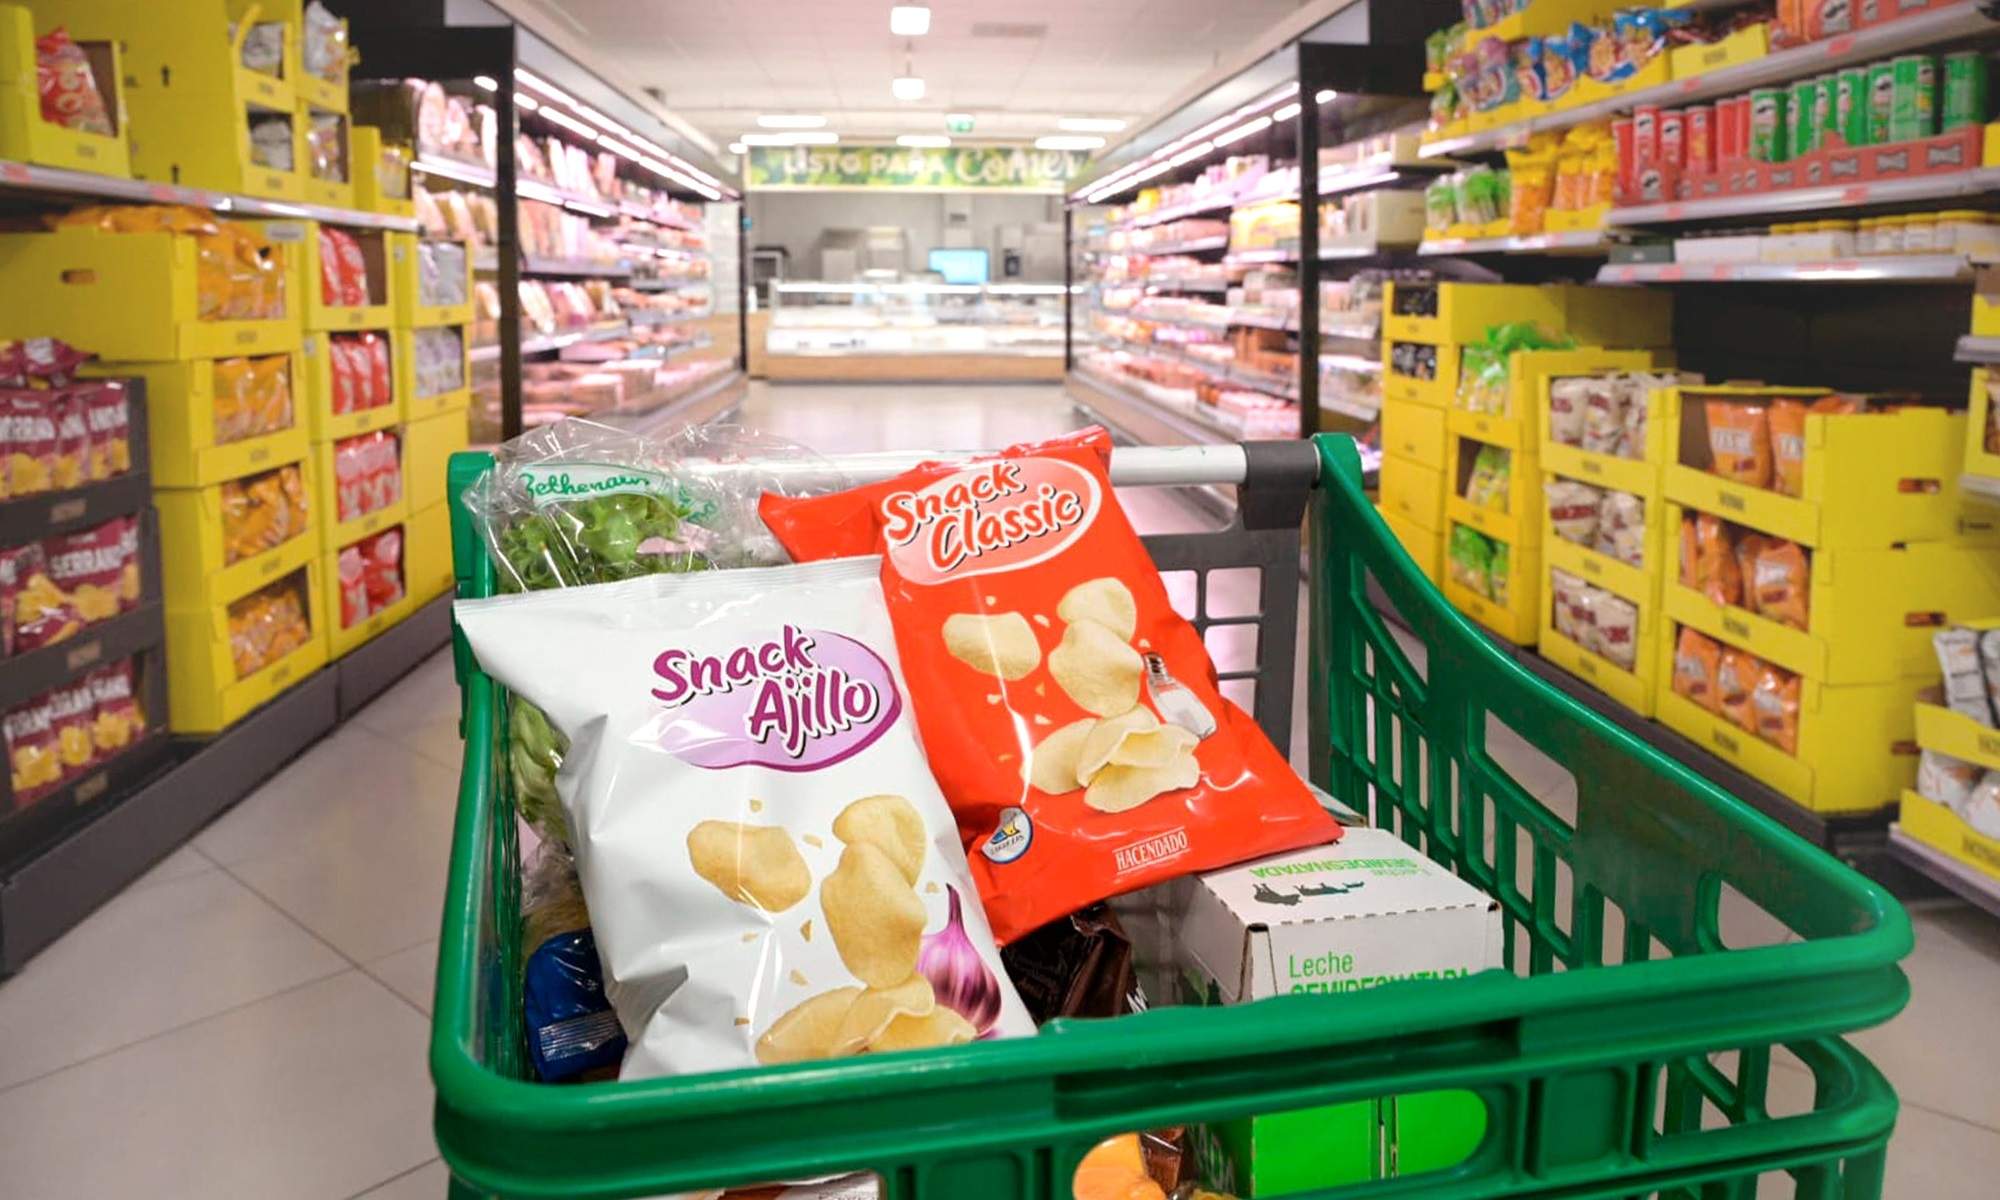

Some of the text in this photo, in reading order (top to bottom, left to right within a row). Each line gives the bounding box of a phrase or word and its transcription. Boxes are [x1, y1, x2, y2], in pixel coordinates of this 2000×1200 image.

[883, 461, 1026, 546] Snack
[929, 484, 1084, 571] Classic
[651, 624, 815, 705] Snack
[749, 670, 878, 756] Ajillo
[1115, 829, 1188, 871] HACENDADO
[1290, 951, 1354, 978] Leche
